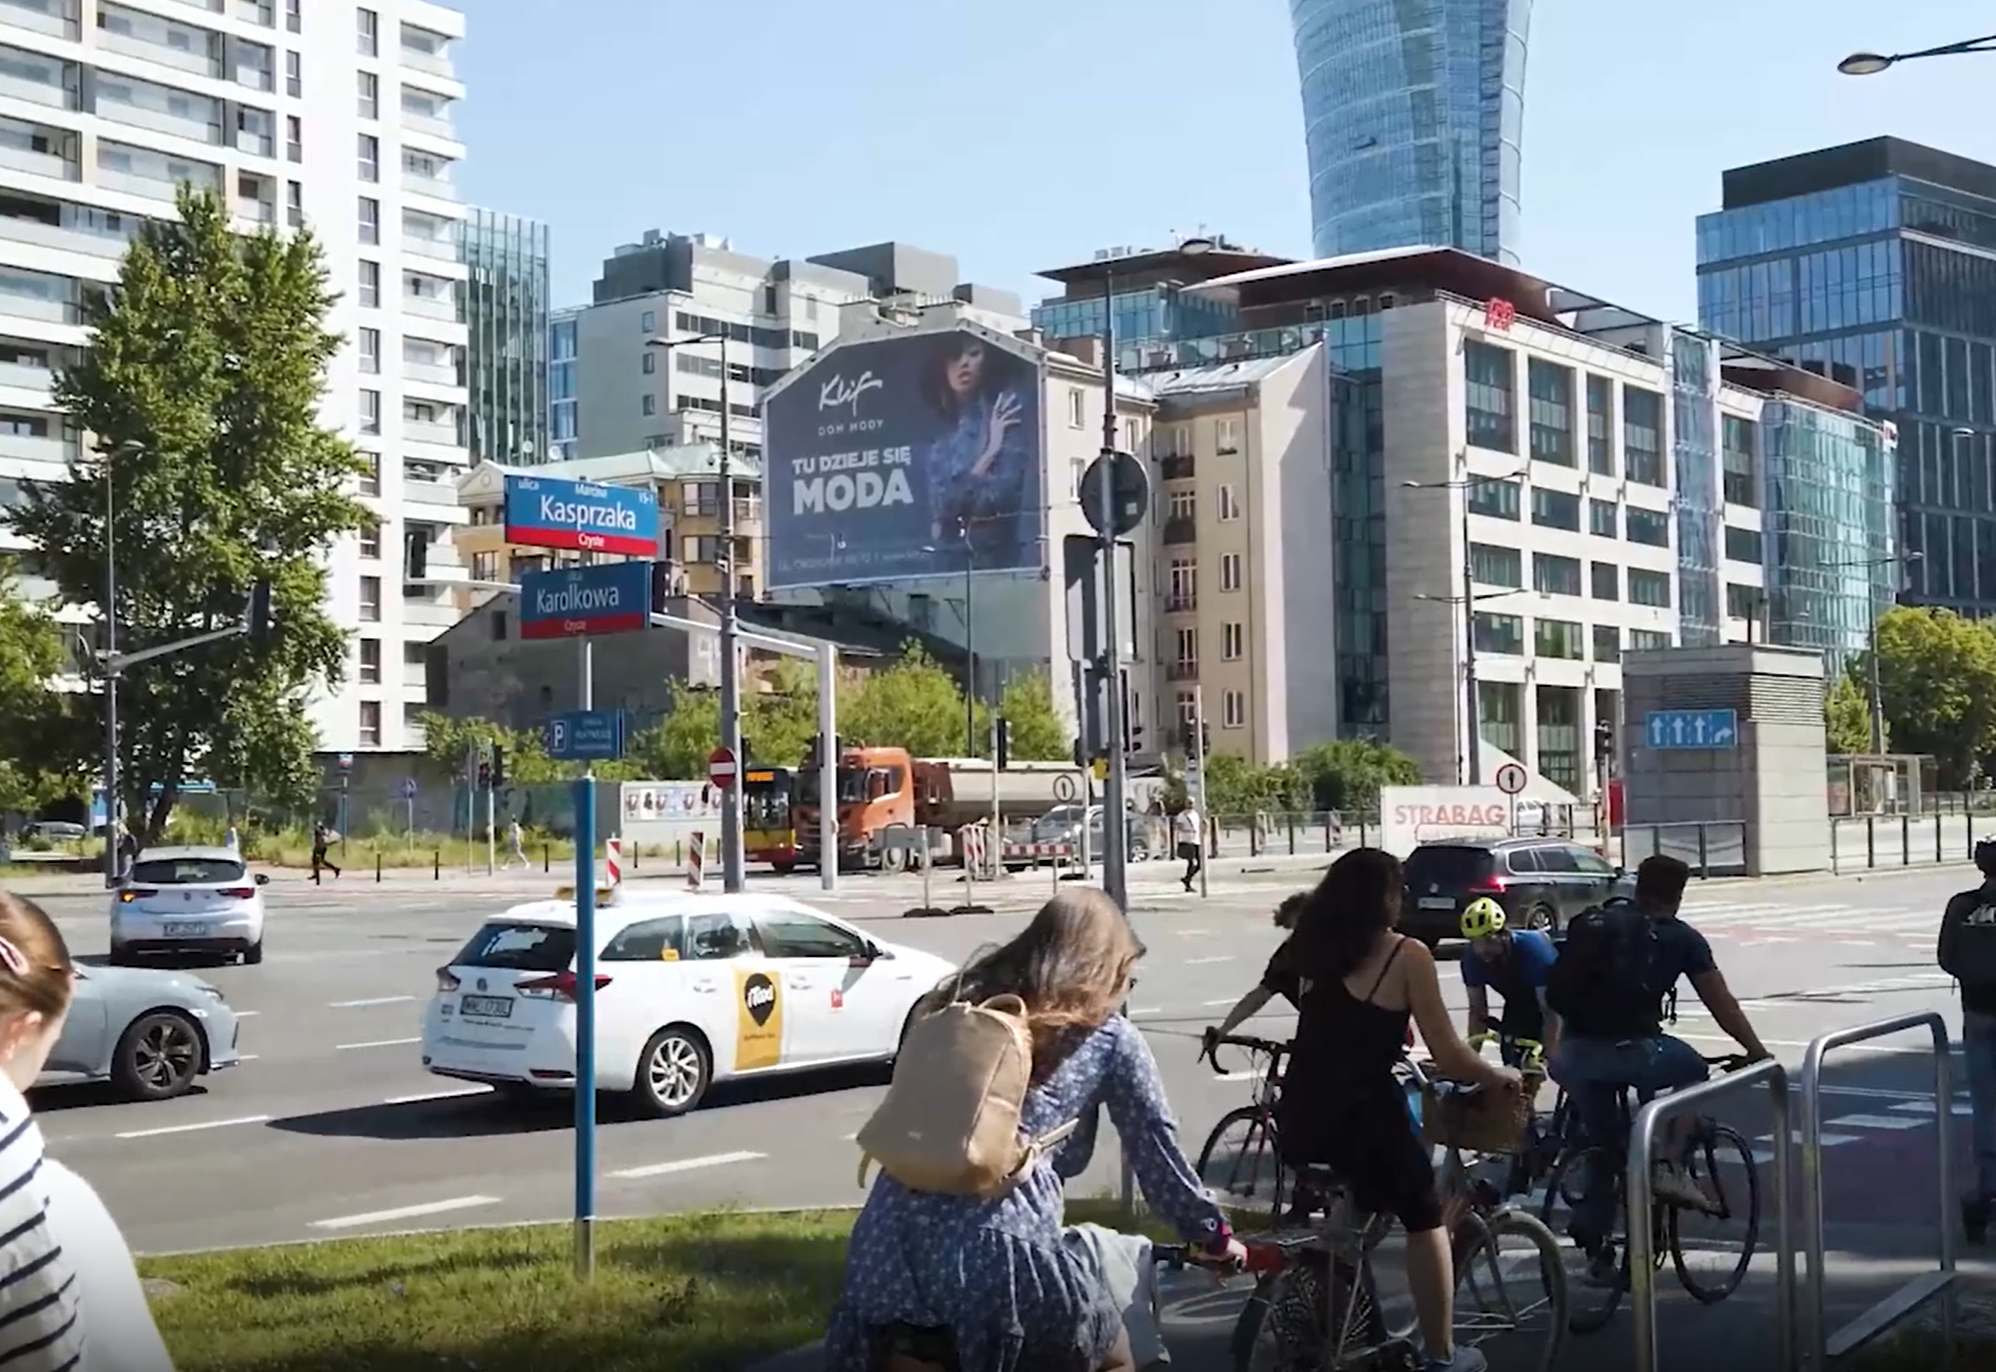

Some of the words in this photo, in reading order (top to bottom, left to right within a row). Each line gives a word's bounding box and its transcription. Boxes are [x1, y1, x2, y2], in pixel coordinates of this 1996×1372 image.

[818, 424, 844, 436] DOM
[792, 457, 815, 475] TU
[819, 449, 879, 472] DZIEJE
[882, 446, 911, 466] SIĘ
[793, 468, 914, 515] MODA
[541, 494, 636, 531] Kasprzaka
[578, 532, 604, 548] Czyste
[536, 583, 619, 614] Karolkowa
[1395, 804, 1506, 825] STRABAG
